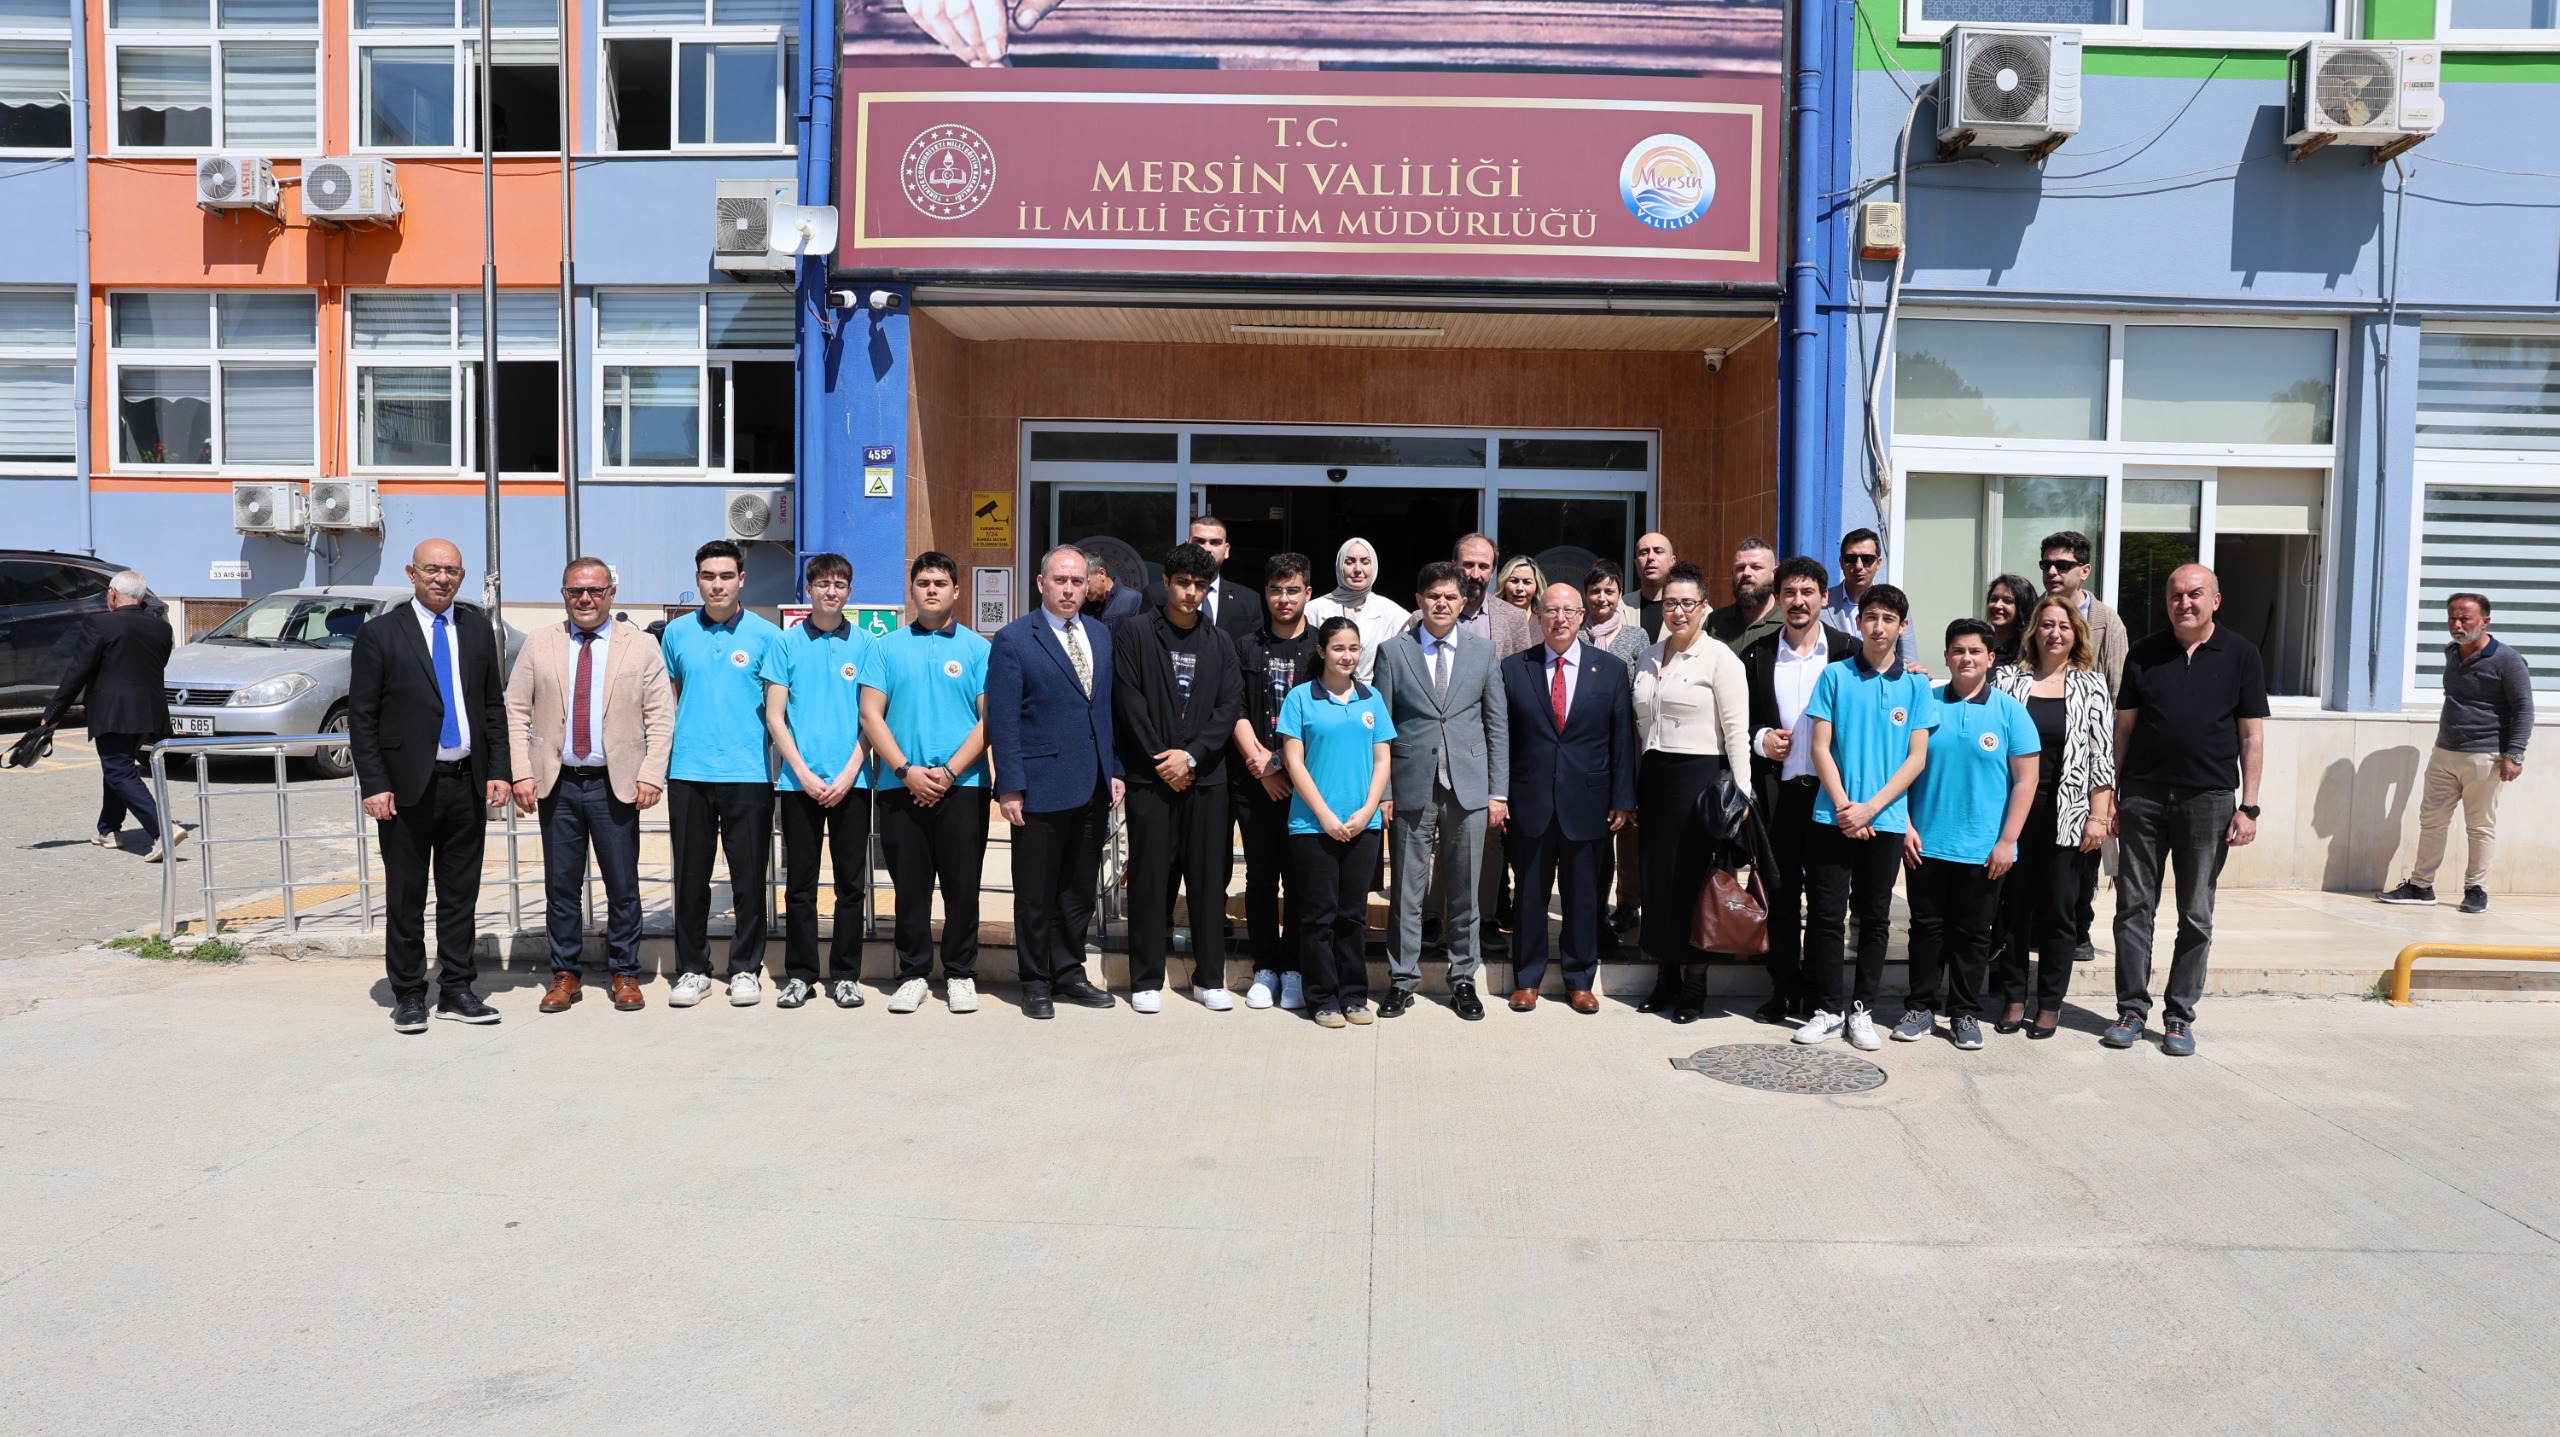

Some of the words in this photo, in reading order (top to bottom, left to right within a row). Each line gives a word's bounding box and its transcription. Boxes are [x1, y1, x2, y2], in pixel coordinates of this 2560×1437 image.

[1267, 116, 1348, 148] T.C.
[241, 160, 251, 197] VESTEL
[359, 165, 369, 208] VESTEL
[1091, 155, 1288, 195] MERSİN
[1303, 158, 1522, 197] VALİLİĞİ
[1018, 201, 1051, 231] İL
[1063, 201, 1168, 232] MİLLİ
[1183, 203, 1325, 234] EĞİTİM
[1336, 206, 1598, 238] MÜDÜRLÜĞÜ
[190, 719, 210, 731] 685
